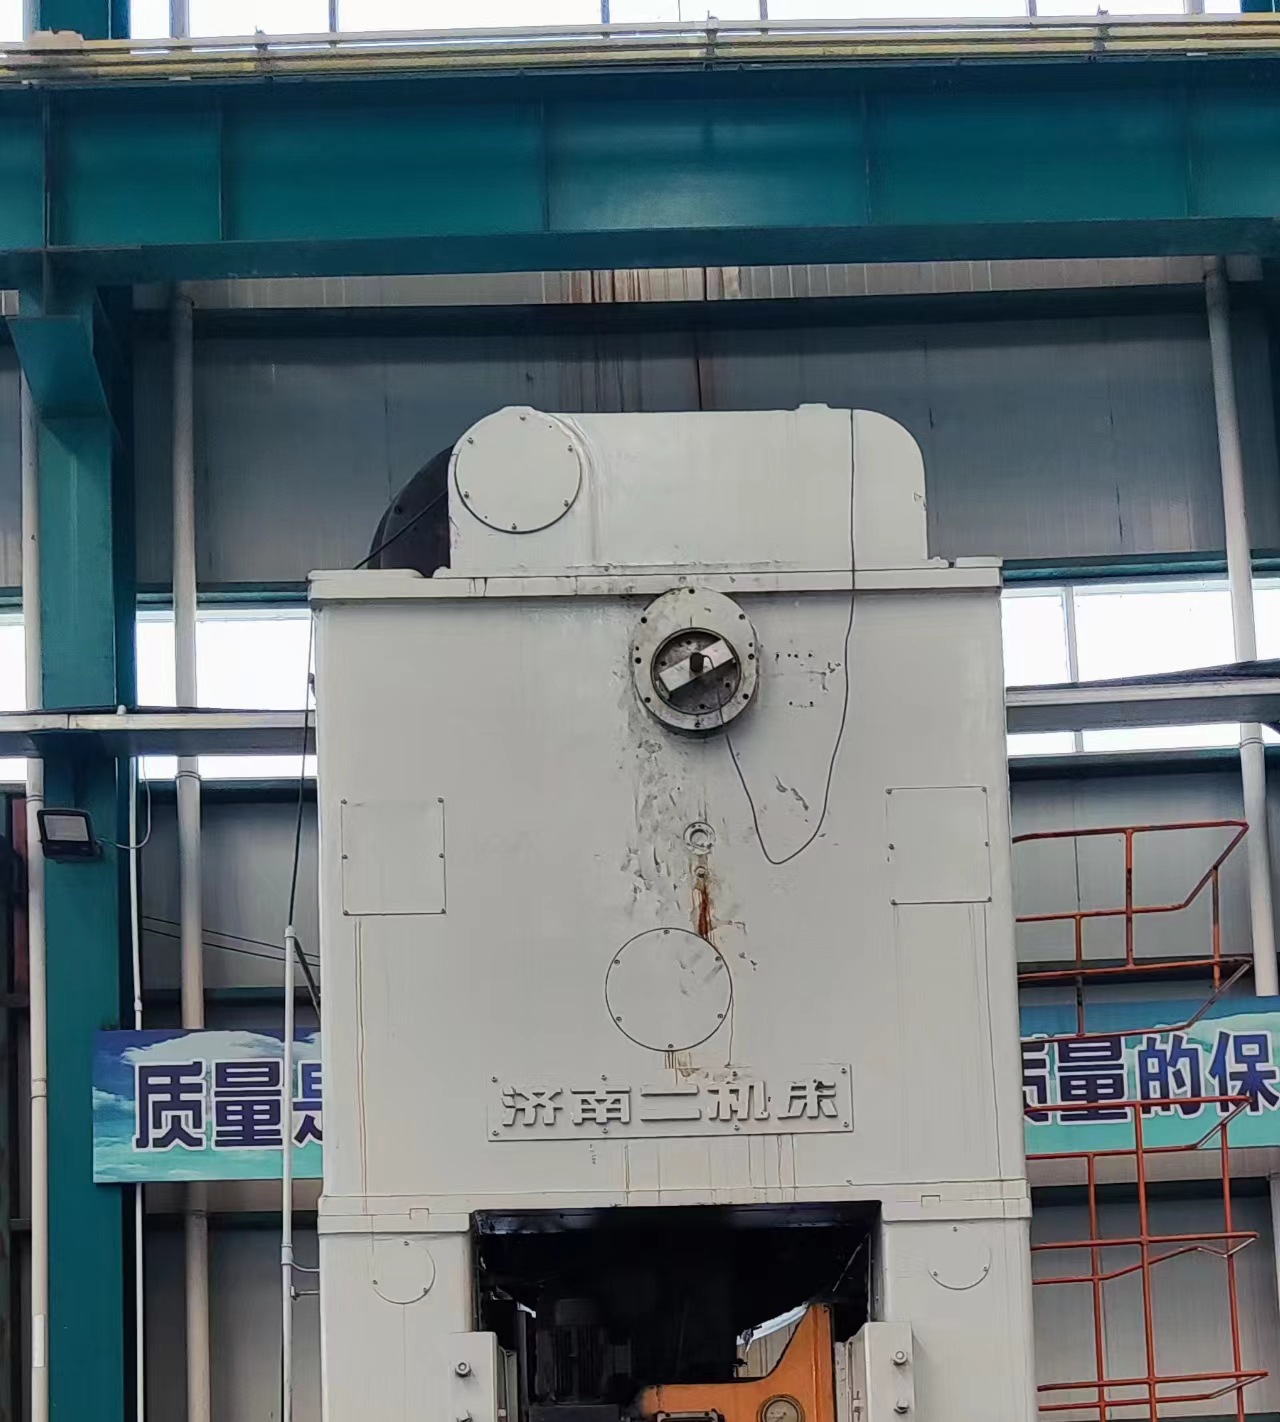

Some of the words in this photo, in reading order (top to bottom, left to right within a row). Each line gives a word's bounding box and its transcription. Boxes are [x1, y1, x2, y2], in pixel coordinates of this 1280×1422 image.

[500, 1080, 839, 1126] 济南二机床
